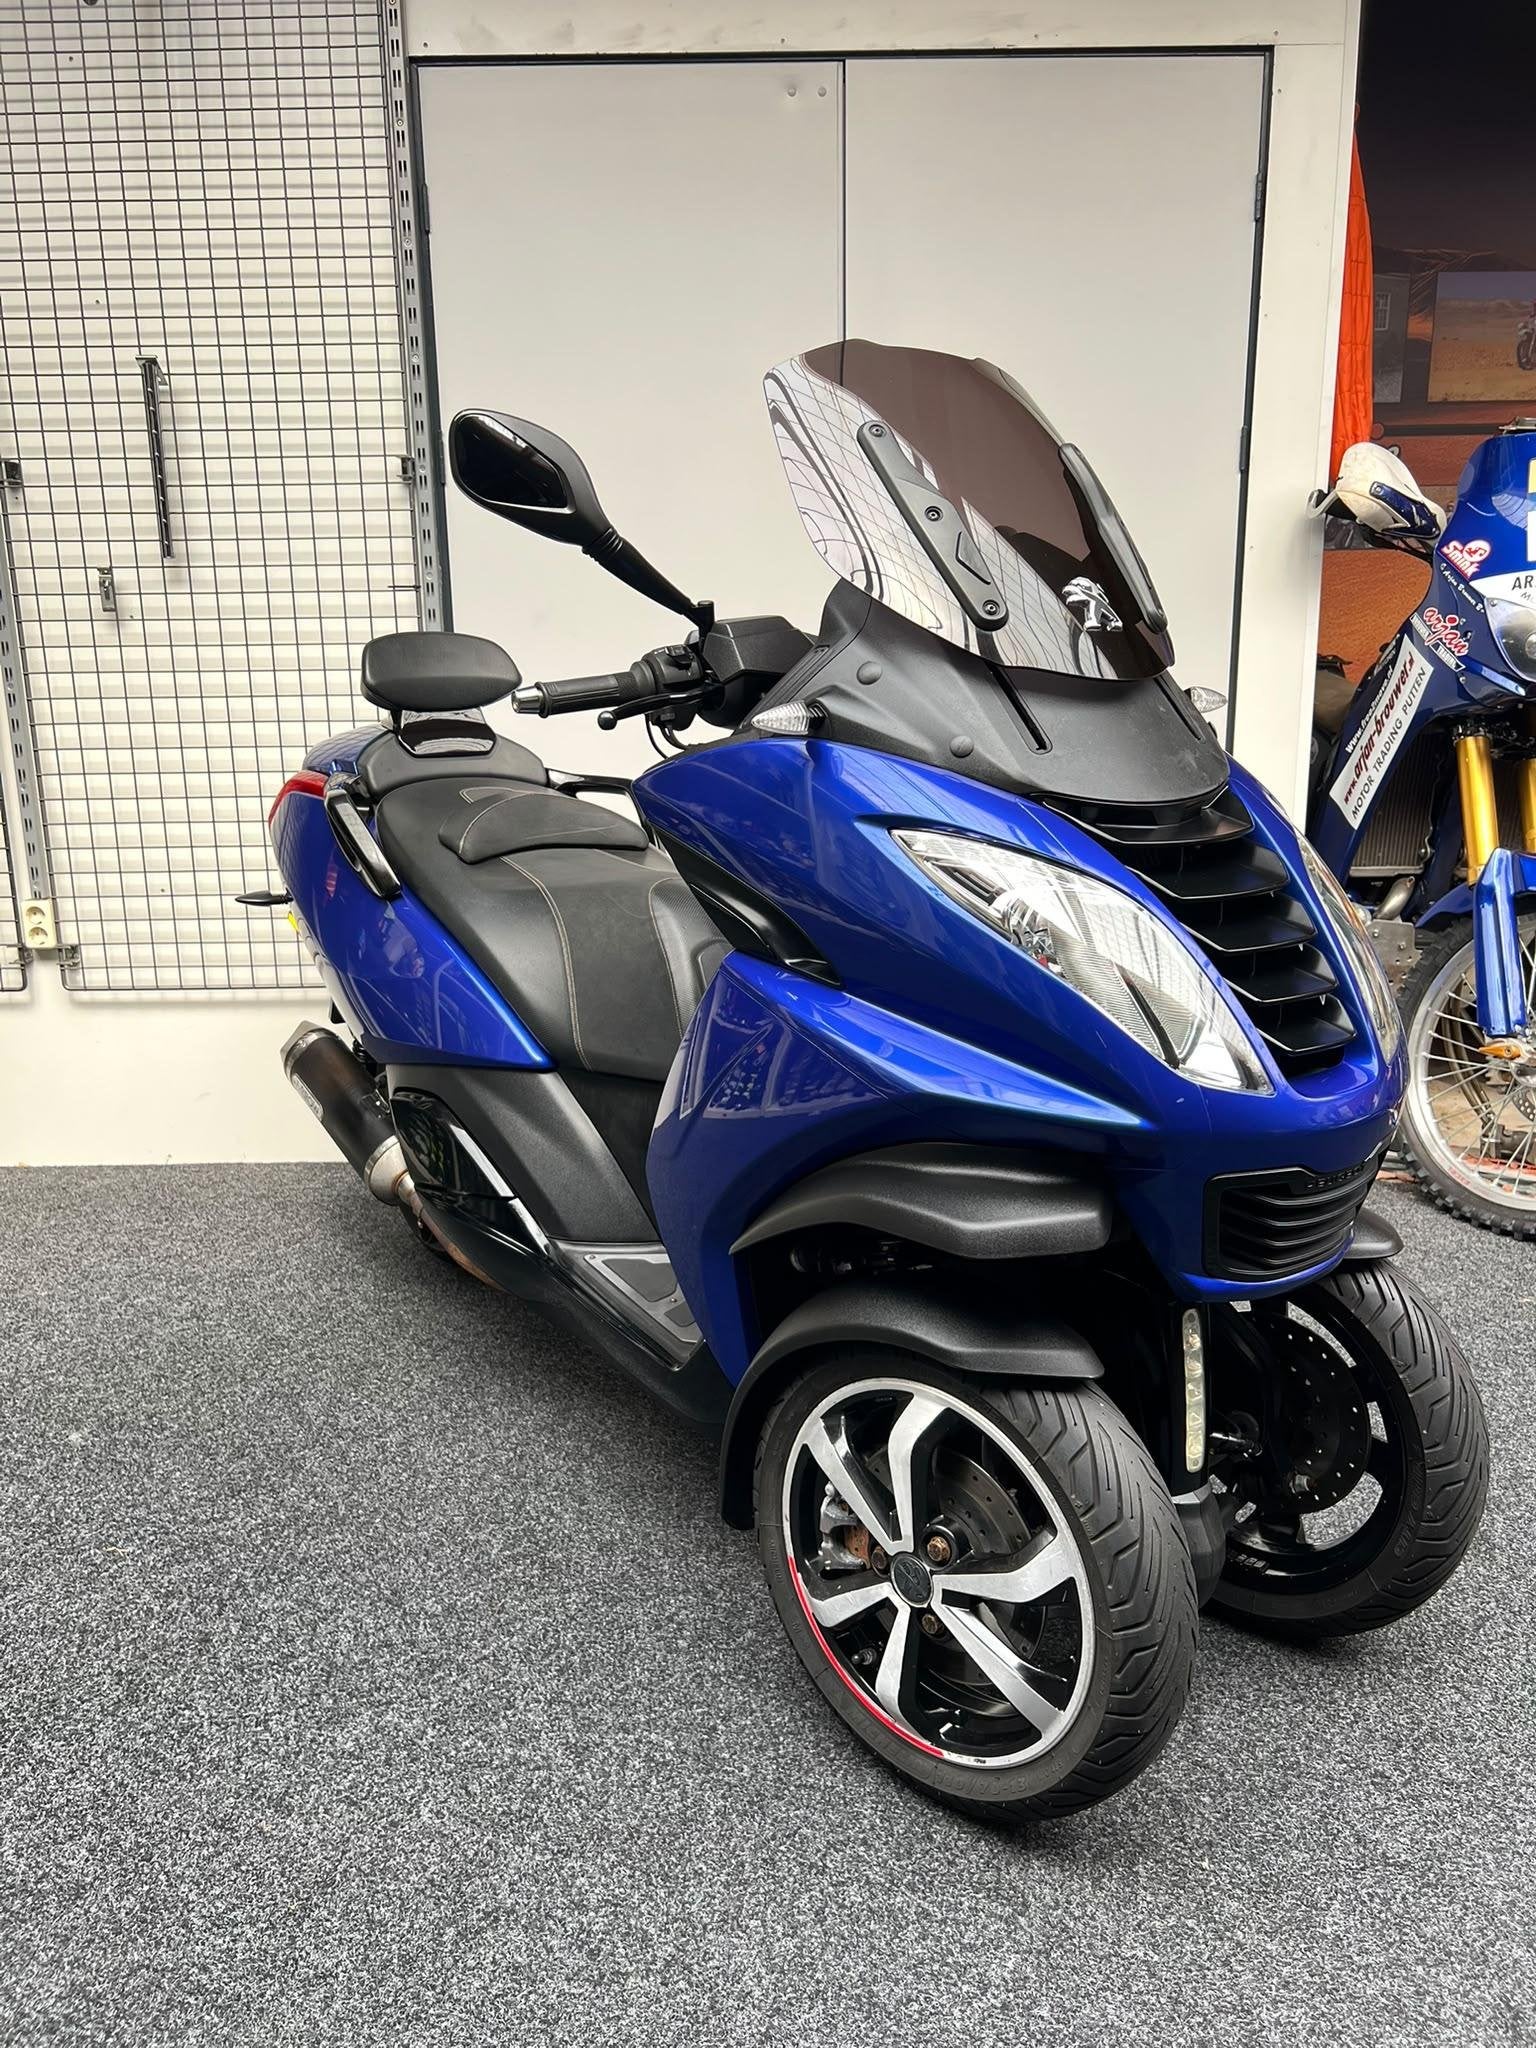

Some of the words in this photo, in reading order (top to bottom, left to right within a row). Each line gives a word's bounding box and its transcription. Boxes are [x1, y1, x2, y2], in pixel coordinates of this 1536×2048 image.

[1441, 540, 1480, 579] Smink
[1424, 608, 1469, 656] arjan
[1343, 651, 1415, 805] www.arjan-brouwer.nl
[1351, 776, 1375, 820] MOTOR
[1373, 718, 1403, 773] TRADING
[1402, 667, 1427, 716] PUTTEN
